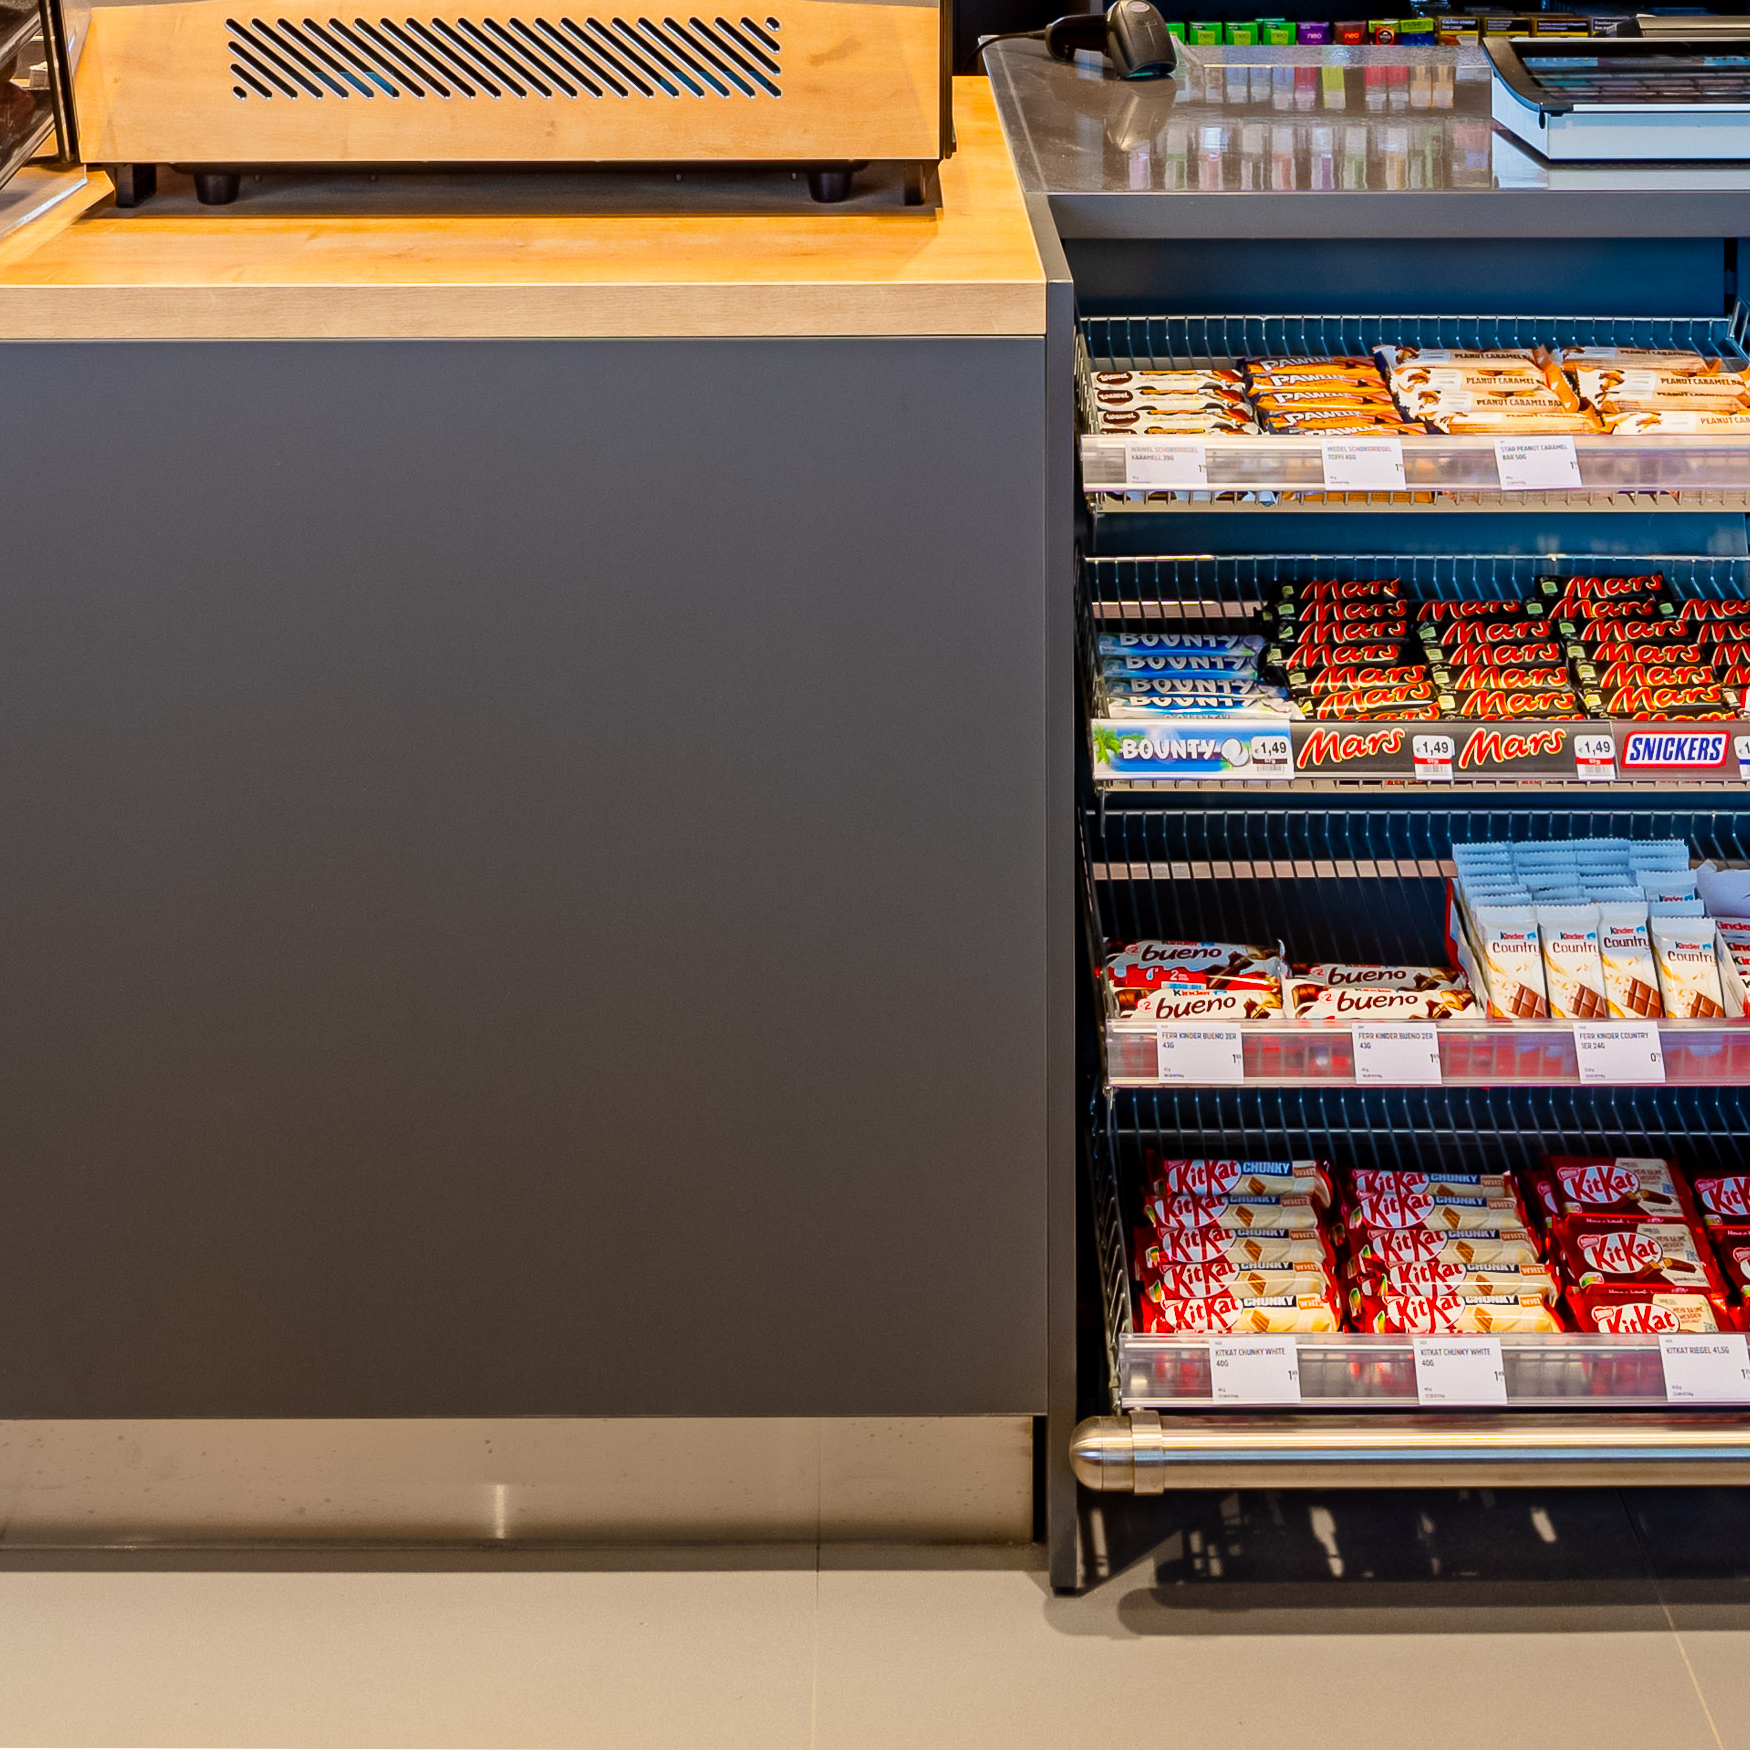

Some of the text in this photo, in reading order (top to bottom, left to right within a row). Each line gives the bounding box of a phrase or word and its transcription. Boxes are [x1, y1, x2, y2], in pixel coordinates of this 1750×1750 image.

[1123, 739, 1217, 761] BOUNTY
[1297, 728, 1406, 770] Mars
[1628, 737, 1724, 763] SNICKERS
[1603, 935, 1650, 949] Country
[1156, 995, 1236, 1020] bueno
[1177, 1160, 1290, 1195] KitKat CHUNKY
